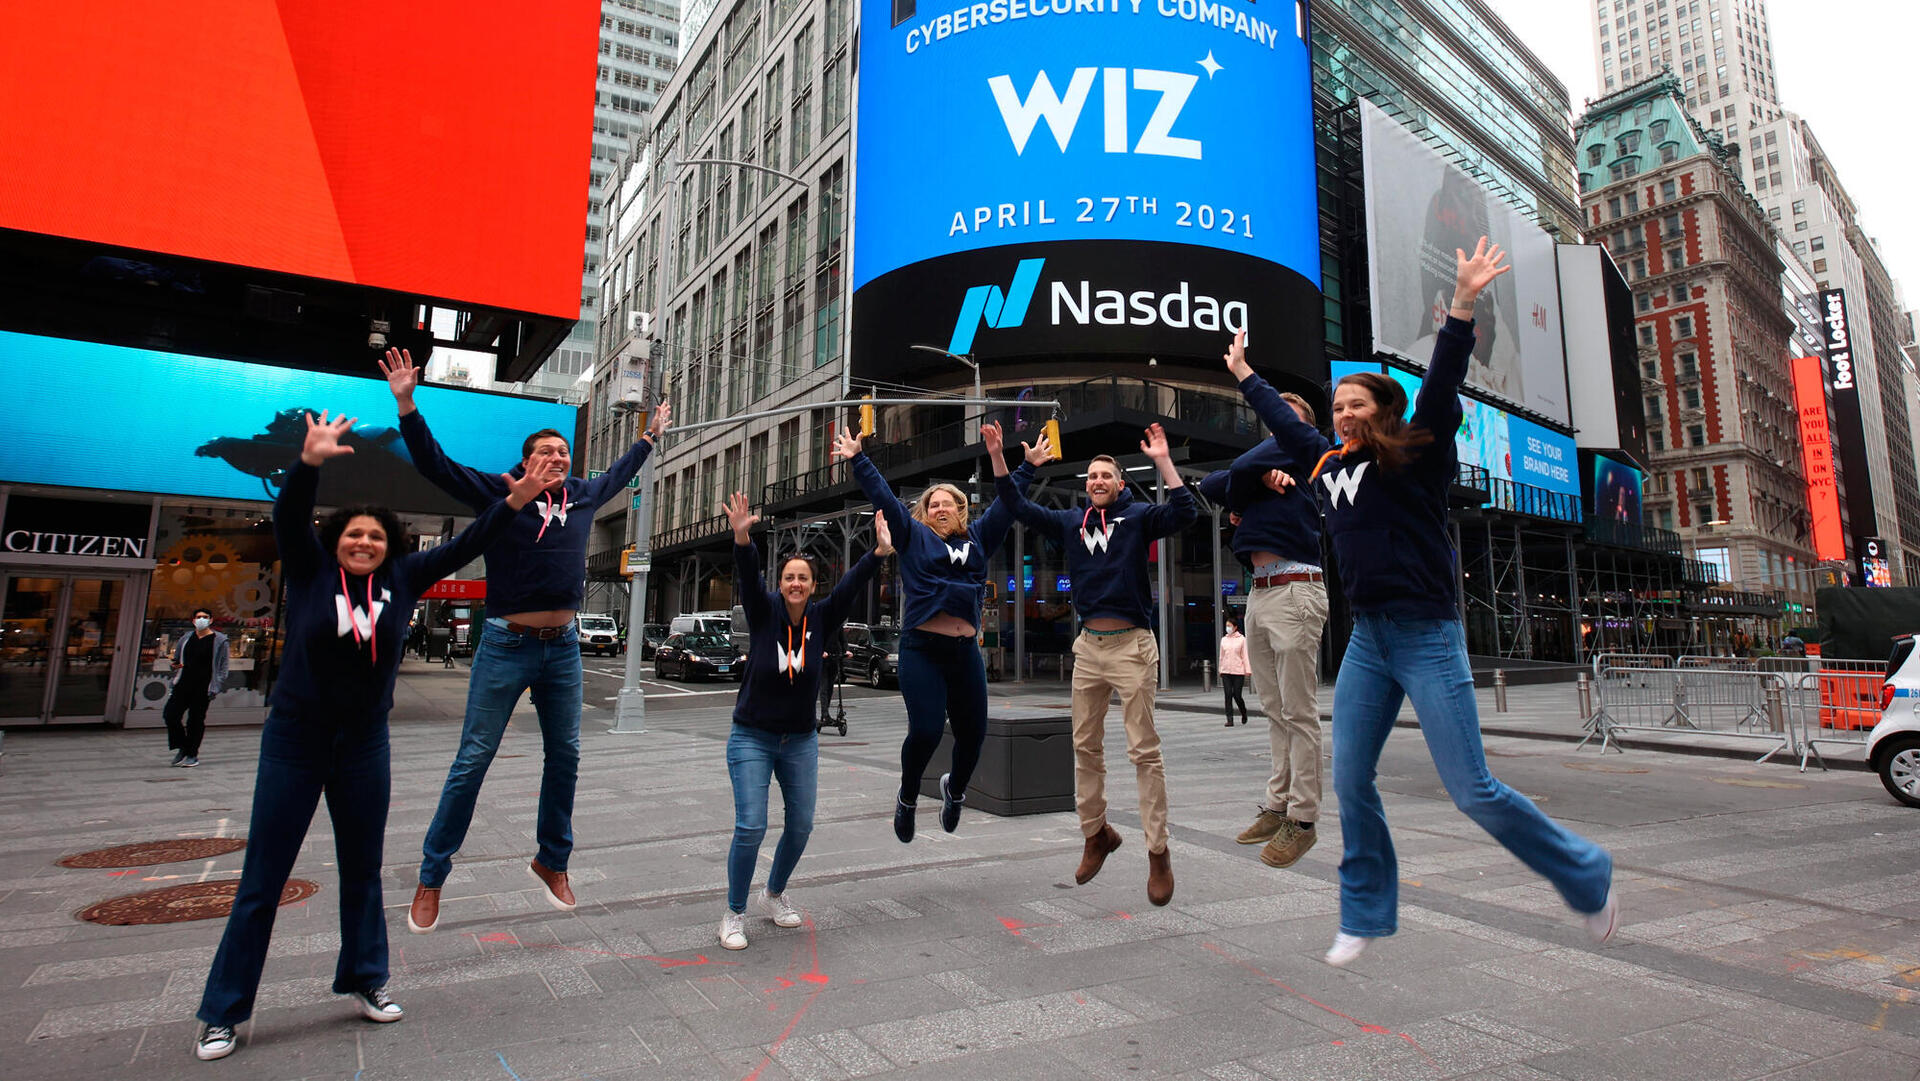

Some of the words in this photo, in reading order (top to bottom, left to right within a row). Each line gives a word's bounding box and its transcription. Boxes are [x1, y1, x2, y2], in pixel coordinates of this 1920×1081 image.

[1158, 0, 1278, 49] COMPANY
[987, 67, 1202, 160] WIZ
[949, 200, 1056, 237] APRIL
[1076, 197, 1158, 223] 27TH
[1176, 202, 1255, 238] 2021
[1051, 281, 1249, 348] Nasdaq
[1832, 352, 1853, 389] Foot
[1803, 407, 1822, 416] ARE
[1804, 420, 1824, 429] YOU
[1527, 436, 1541, 454] SEE
[1542, 442, 1562, 461] YOUR
[1806, 433, 1824, 442] ALL
[1812, 449, 1823, 457] IN
[1524, 456, 1549, 476] BRAND
[1551, 464, 1569, 483] HERE
[1811, 477, 1831, 486] NYC
[1813, 464, 1827, 473] ON
[5, 530, 148, 558] CITIZEN
